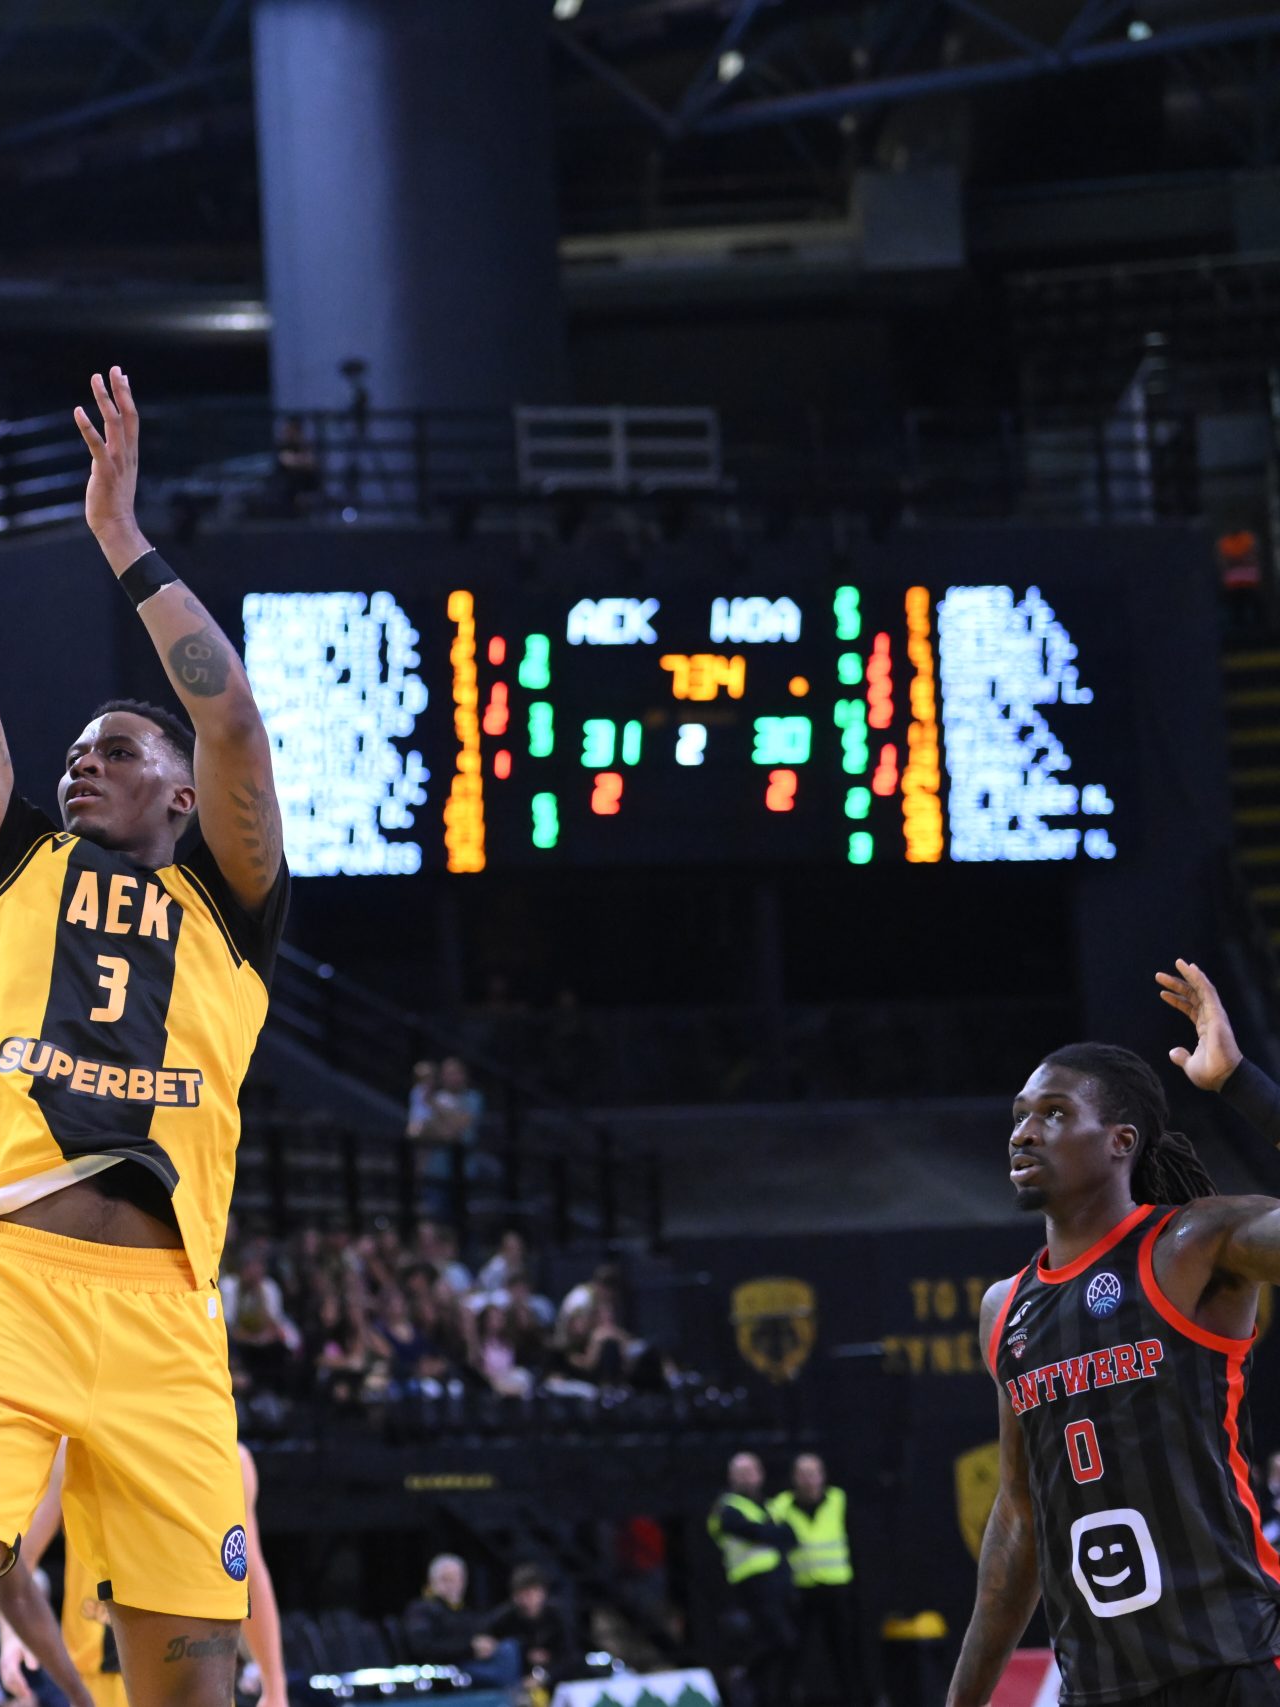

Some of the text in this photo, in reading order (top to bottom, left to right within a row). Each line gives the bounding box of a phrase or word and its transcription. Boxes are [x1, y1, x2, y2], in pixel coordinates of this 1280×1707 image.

[66, 870, 173, 941] AEK
[89, 954, 131, 1023] 3
[1006, 1338, 1164, 1416] ANTWERP
[1064, 1418, 1104, 1484] 0
